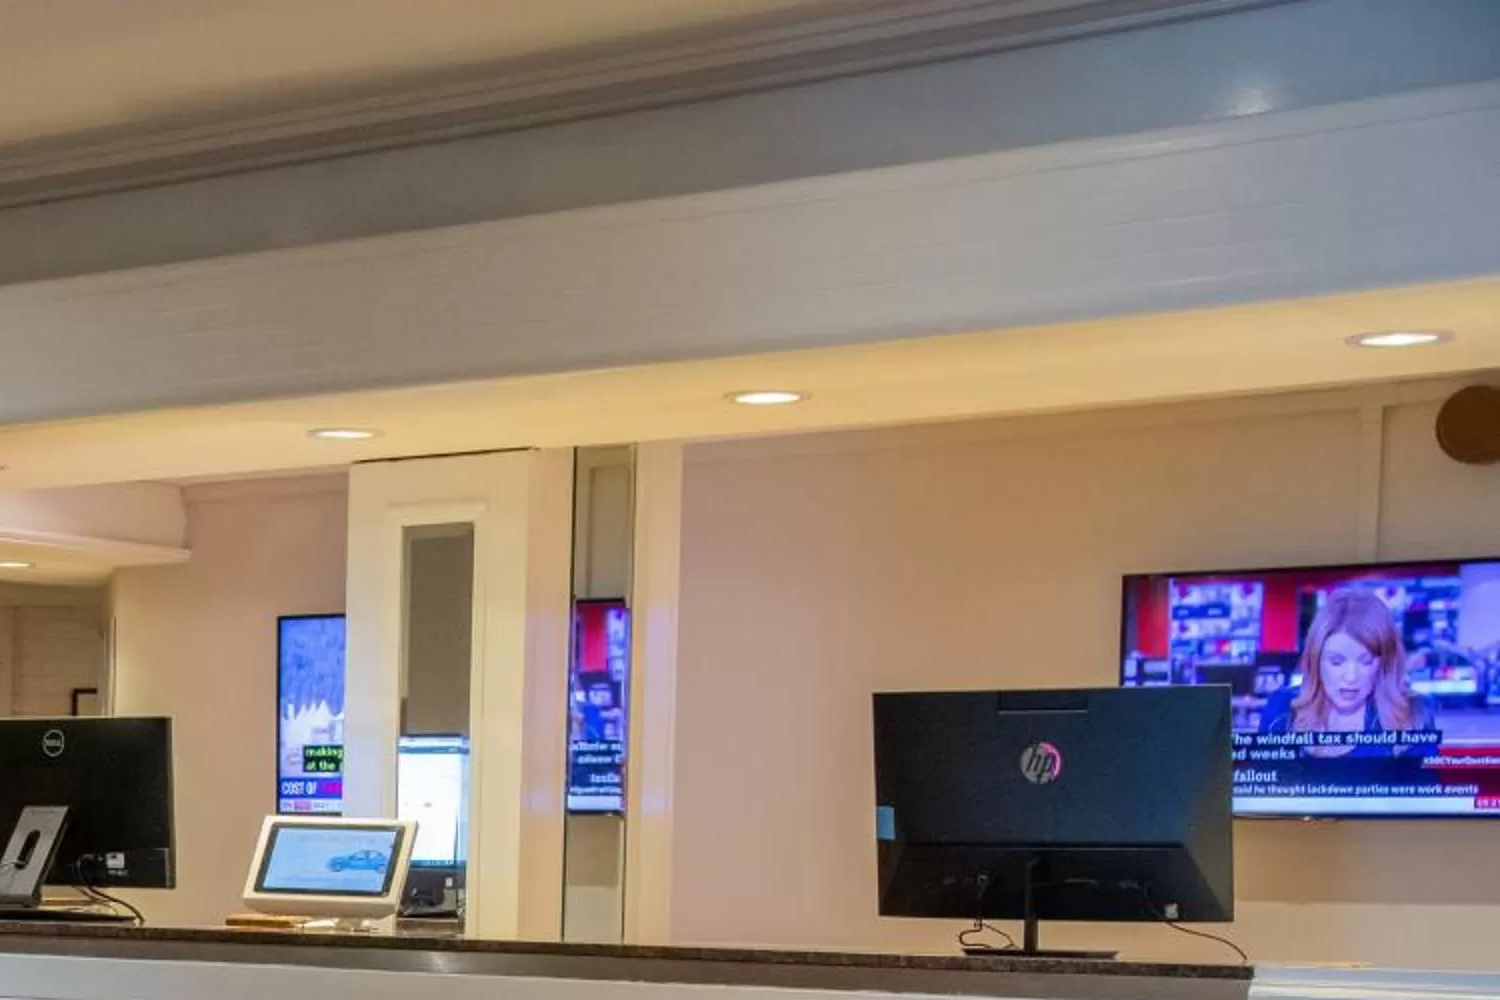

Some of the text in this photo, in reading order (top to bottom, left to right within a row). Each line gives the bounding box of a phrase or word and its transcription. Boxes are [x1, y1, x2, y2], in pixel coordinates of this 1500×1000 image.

[1231, 731, 1439, 745] he windfall tax should have
[1250, 747, 1296, 760] weeks
[1233, 769, 1278, 783] fallout
